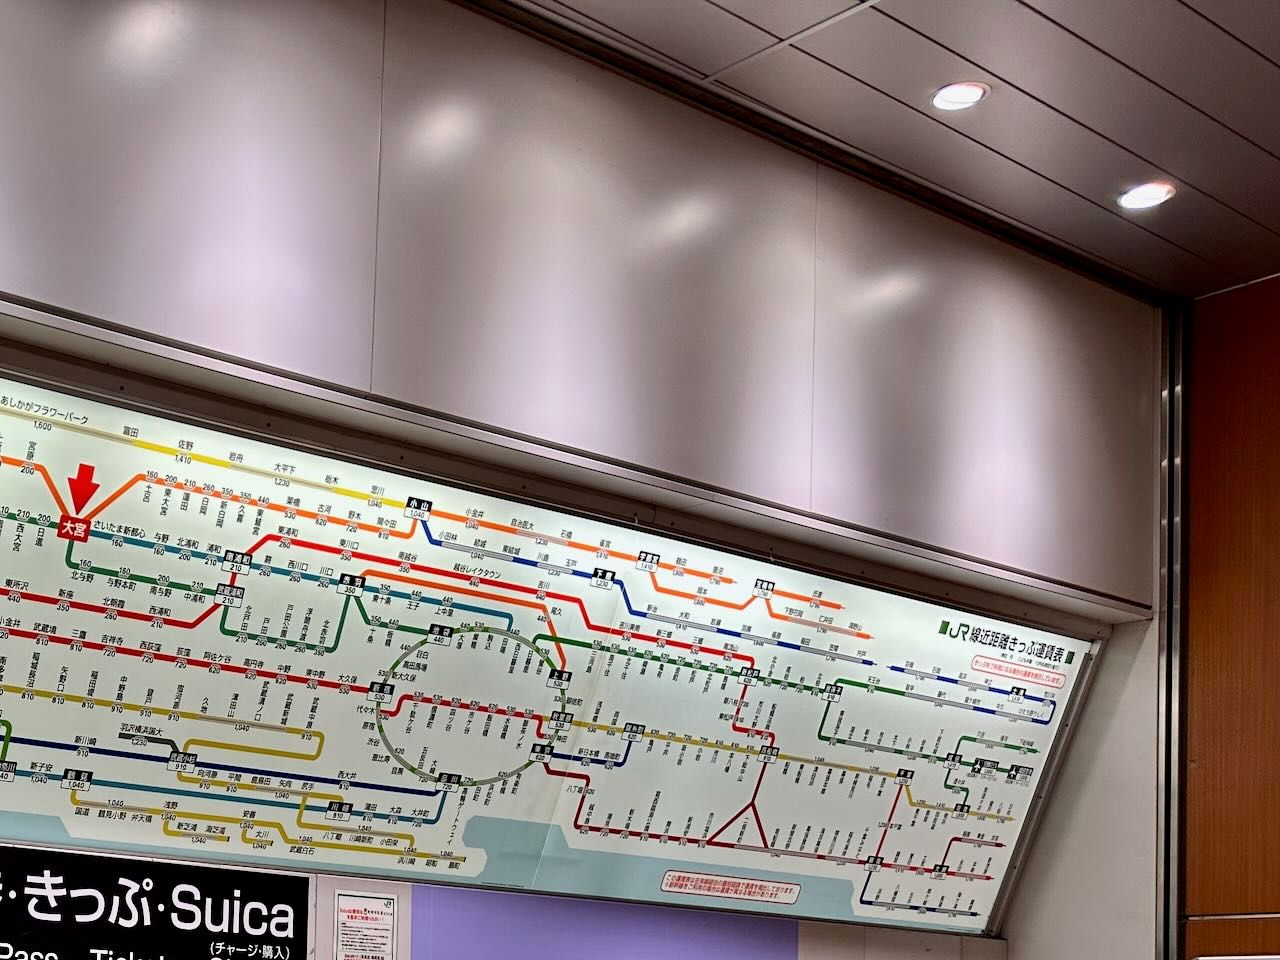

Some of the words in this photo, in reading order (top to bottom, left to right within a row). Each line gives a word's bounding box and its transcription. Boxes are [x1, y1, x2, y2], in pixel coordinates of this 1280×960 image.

[33, 421, 52, 431] 1,600
[61, 521, 88, 538] 大宮
[94, 520, 146, 539] さいたま新都心
[230, 564, 243, 572] 210
